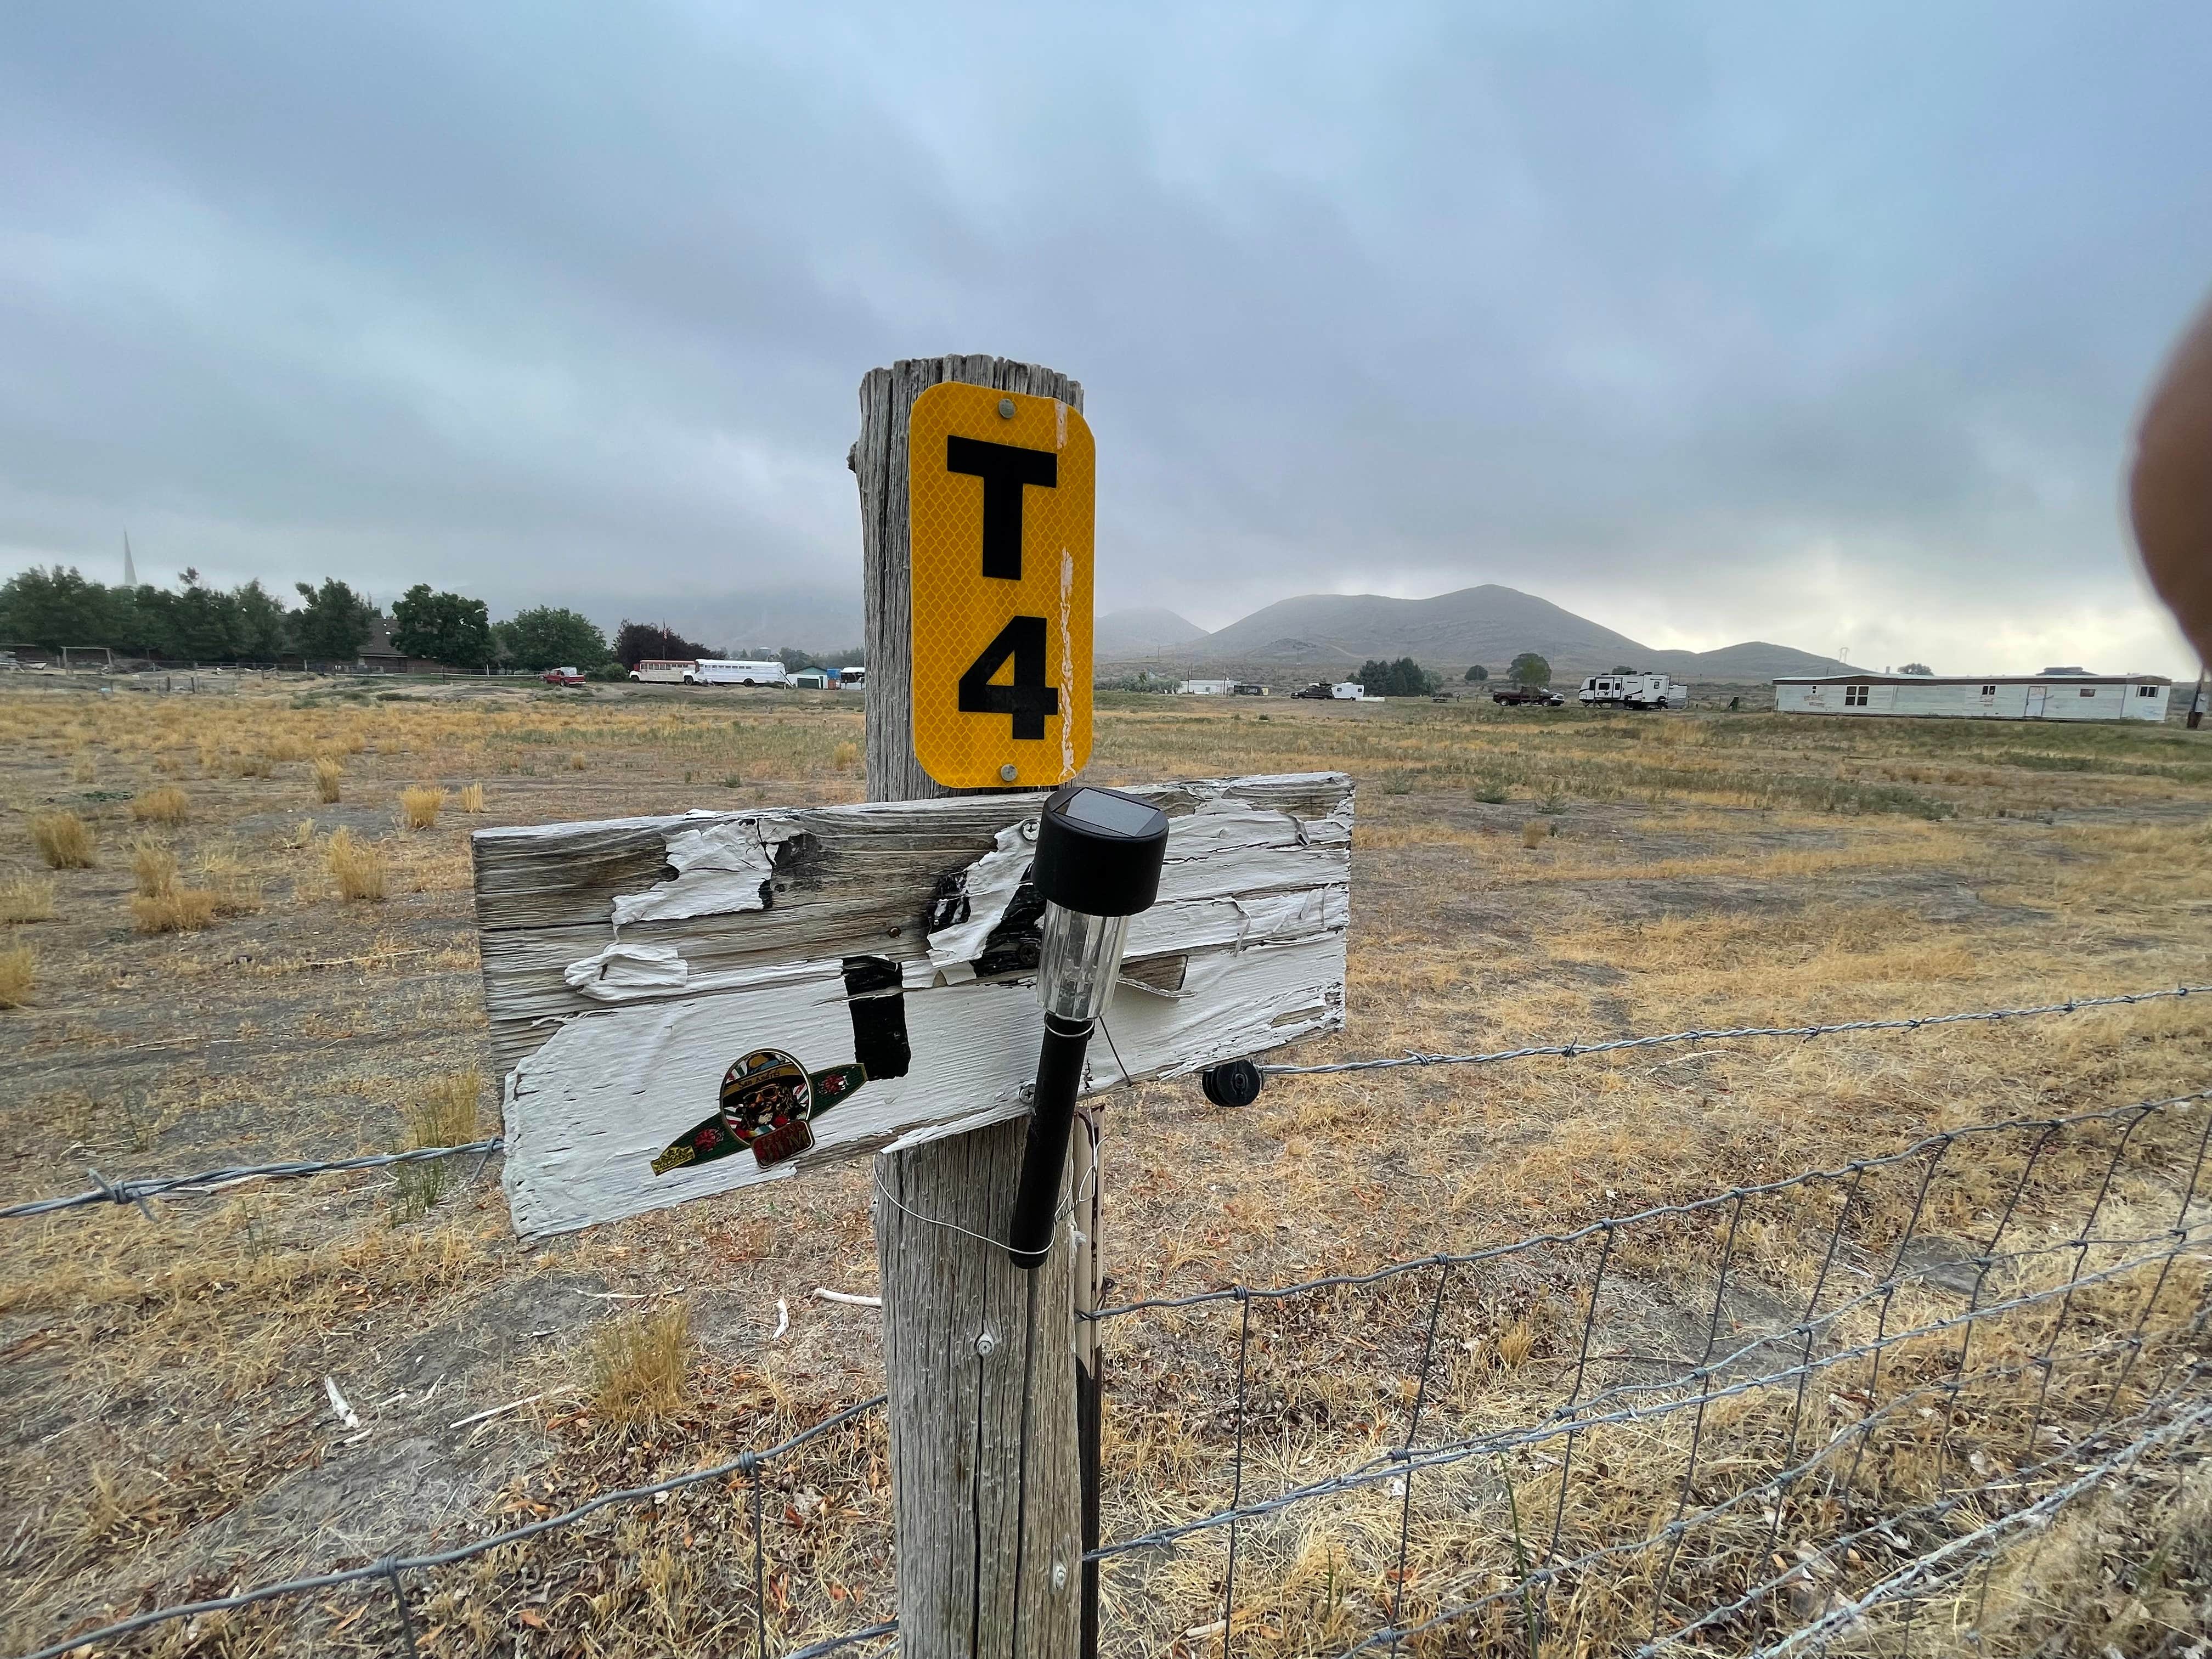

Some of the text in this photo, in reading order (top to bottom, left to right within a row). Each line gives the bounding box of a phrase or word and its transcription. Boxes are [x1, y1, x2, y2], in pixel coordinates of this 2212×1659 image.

[947, 435, 1057, 580] T
[958, 616, 1058, 740] 4
[738, 1079, 753, 1089] San
